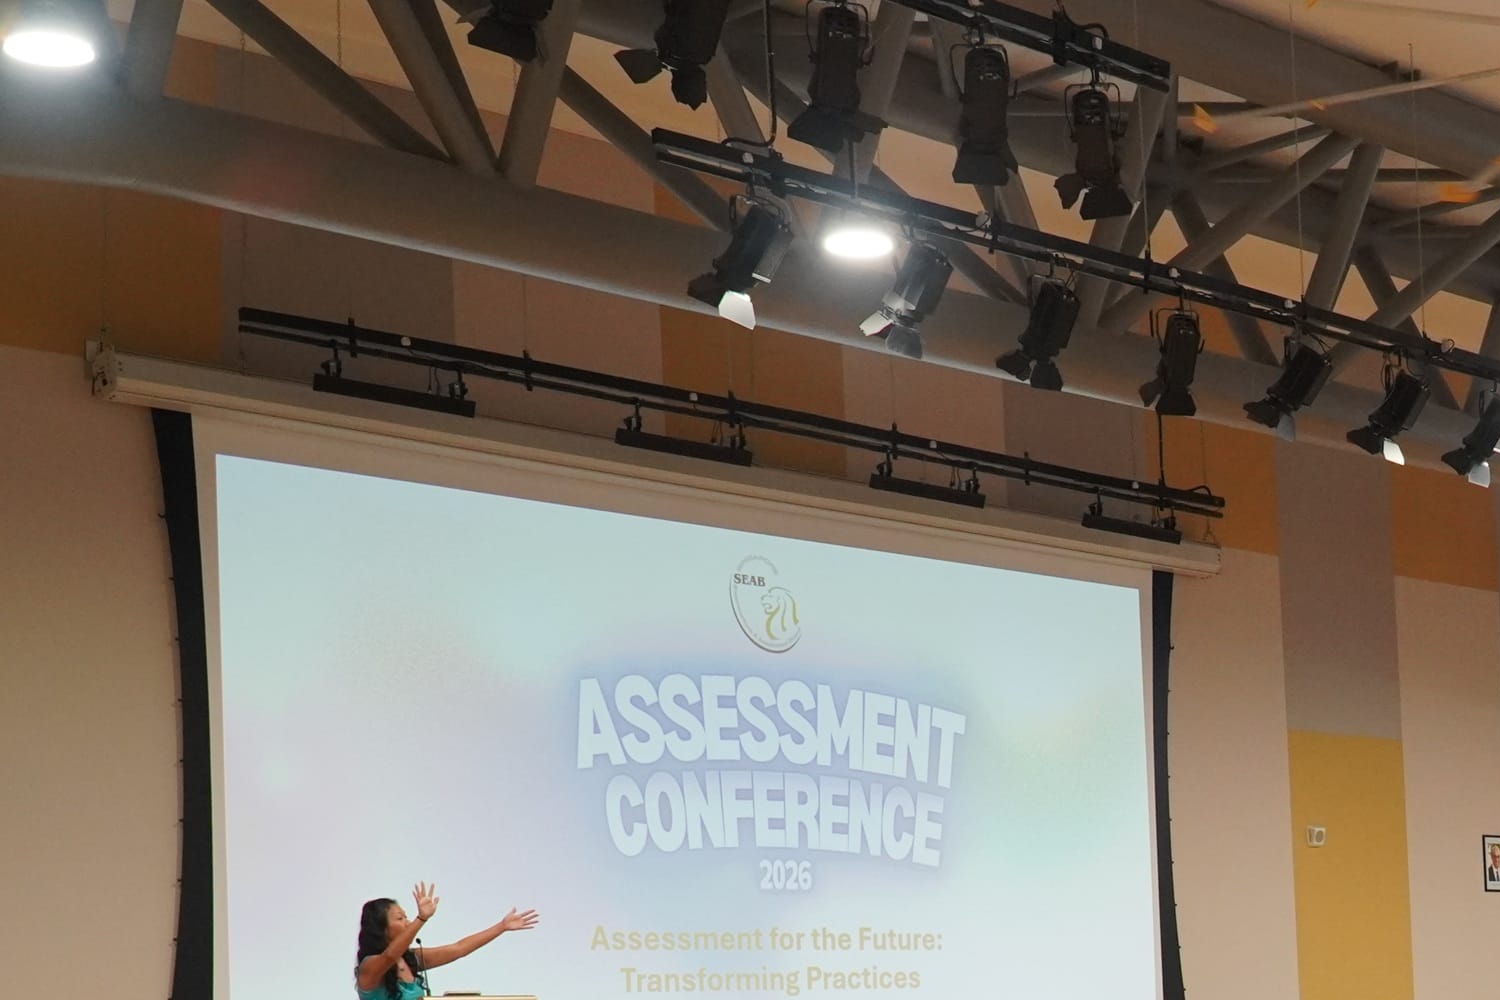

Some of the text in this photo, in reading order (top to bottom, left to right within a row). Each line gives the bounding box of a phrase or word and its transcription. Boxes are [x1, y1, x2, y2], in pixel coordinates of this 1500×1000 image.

[733, 573, 766, 587] SEAB
[576, 673, 967, 788] ASSESSMENT
[606, 770, 945, 867] CONFERENCE
[759, 859, 812, 890] 2026
[590, 924, 943, 951] Assessment for the Future:
[620, 964, 921, 997] Transforming Practices
